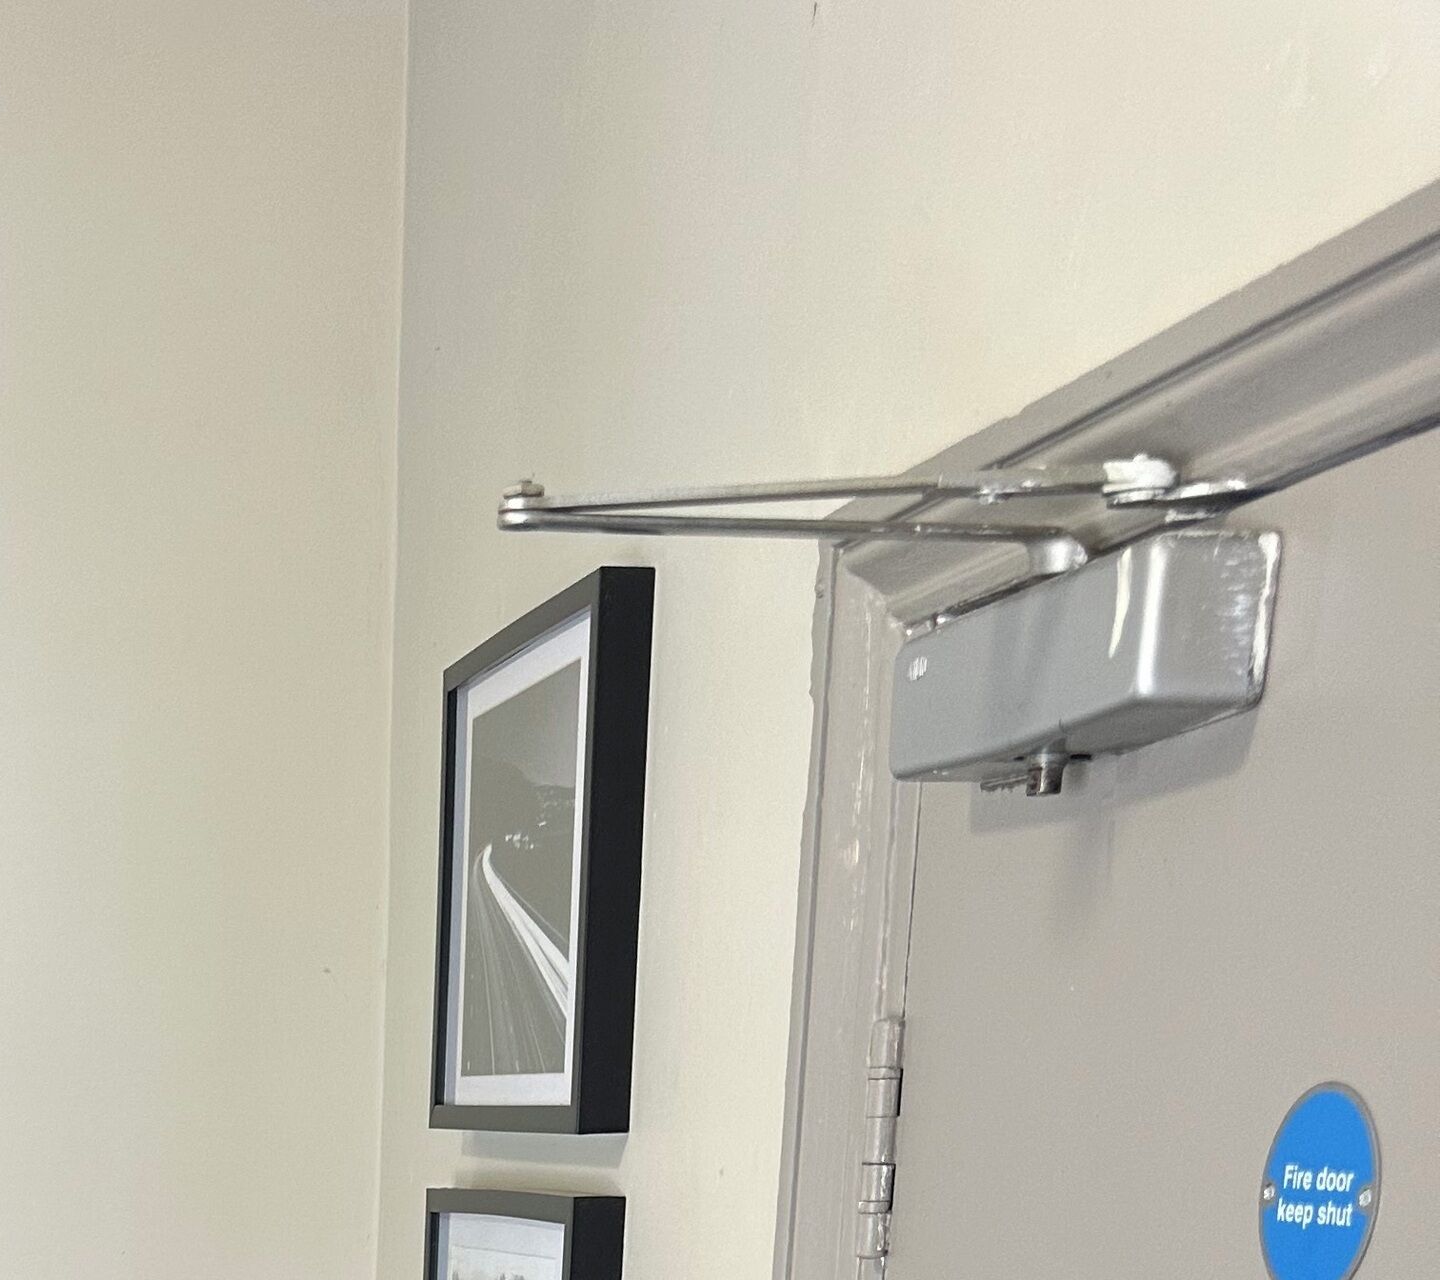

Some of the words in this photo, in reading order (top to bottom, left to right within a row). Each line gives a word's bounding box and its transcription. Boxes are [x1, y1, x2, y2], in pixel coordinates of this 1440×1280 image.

[1283, 1164, 1313, 1191] Fire
[1316, 1166, 1354, 1192] door
[1276, 1198, 1313, 1230] keep
[1317, 1201, 1353, 1227] shut
